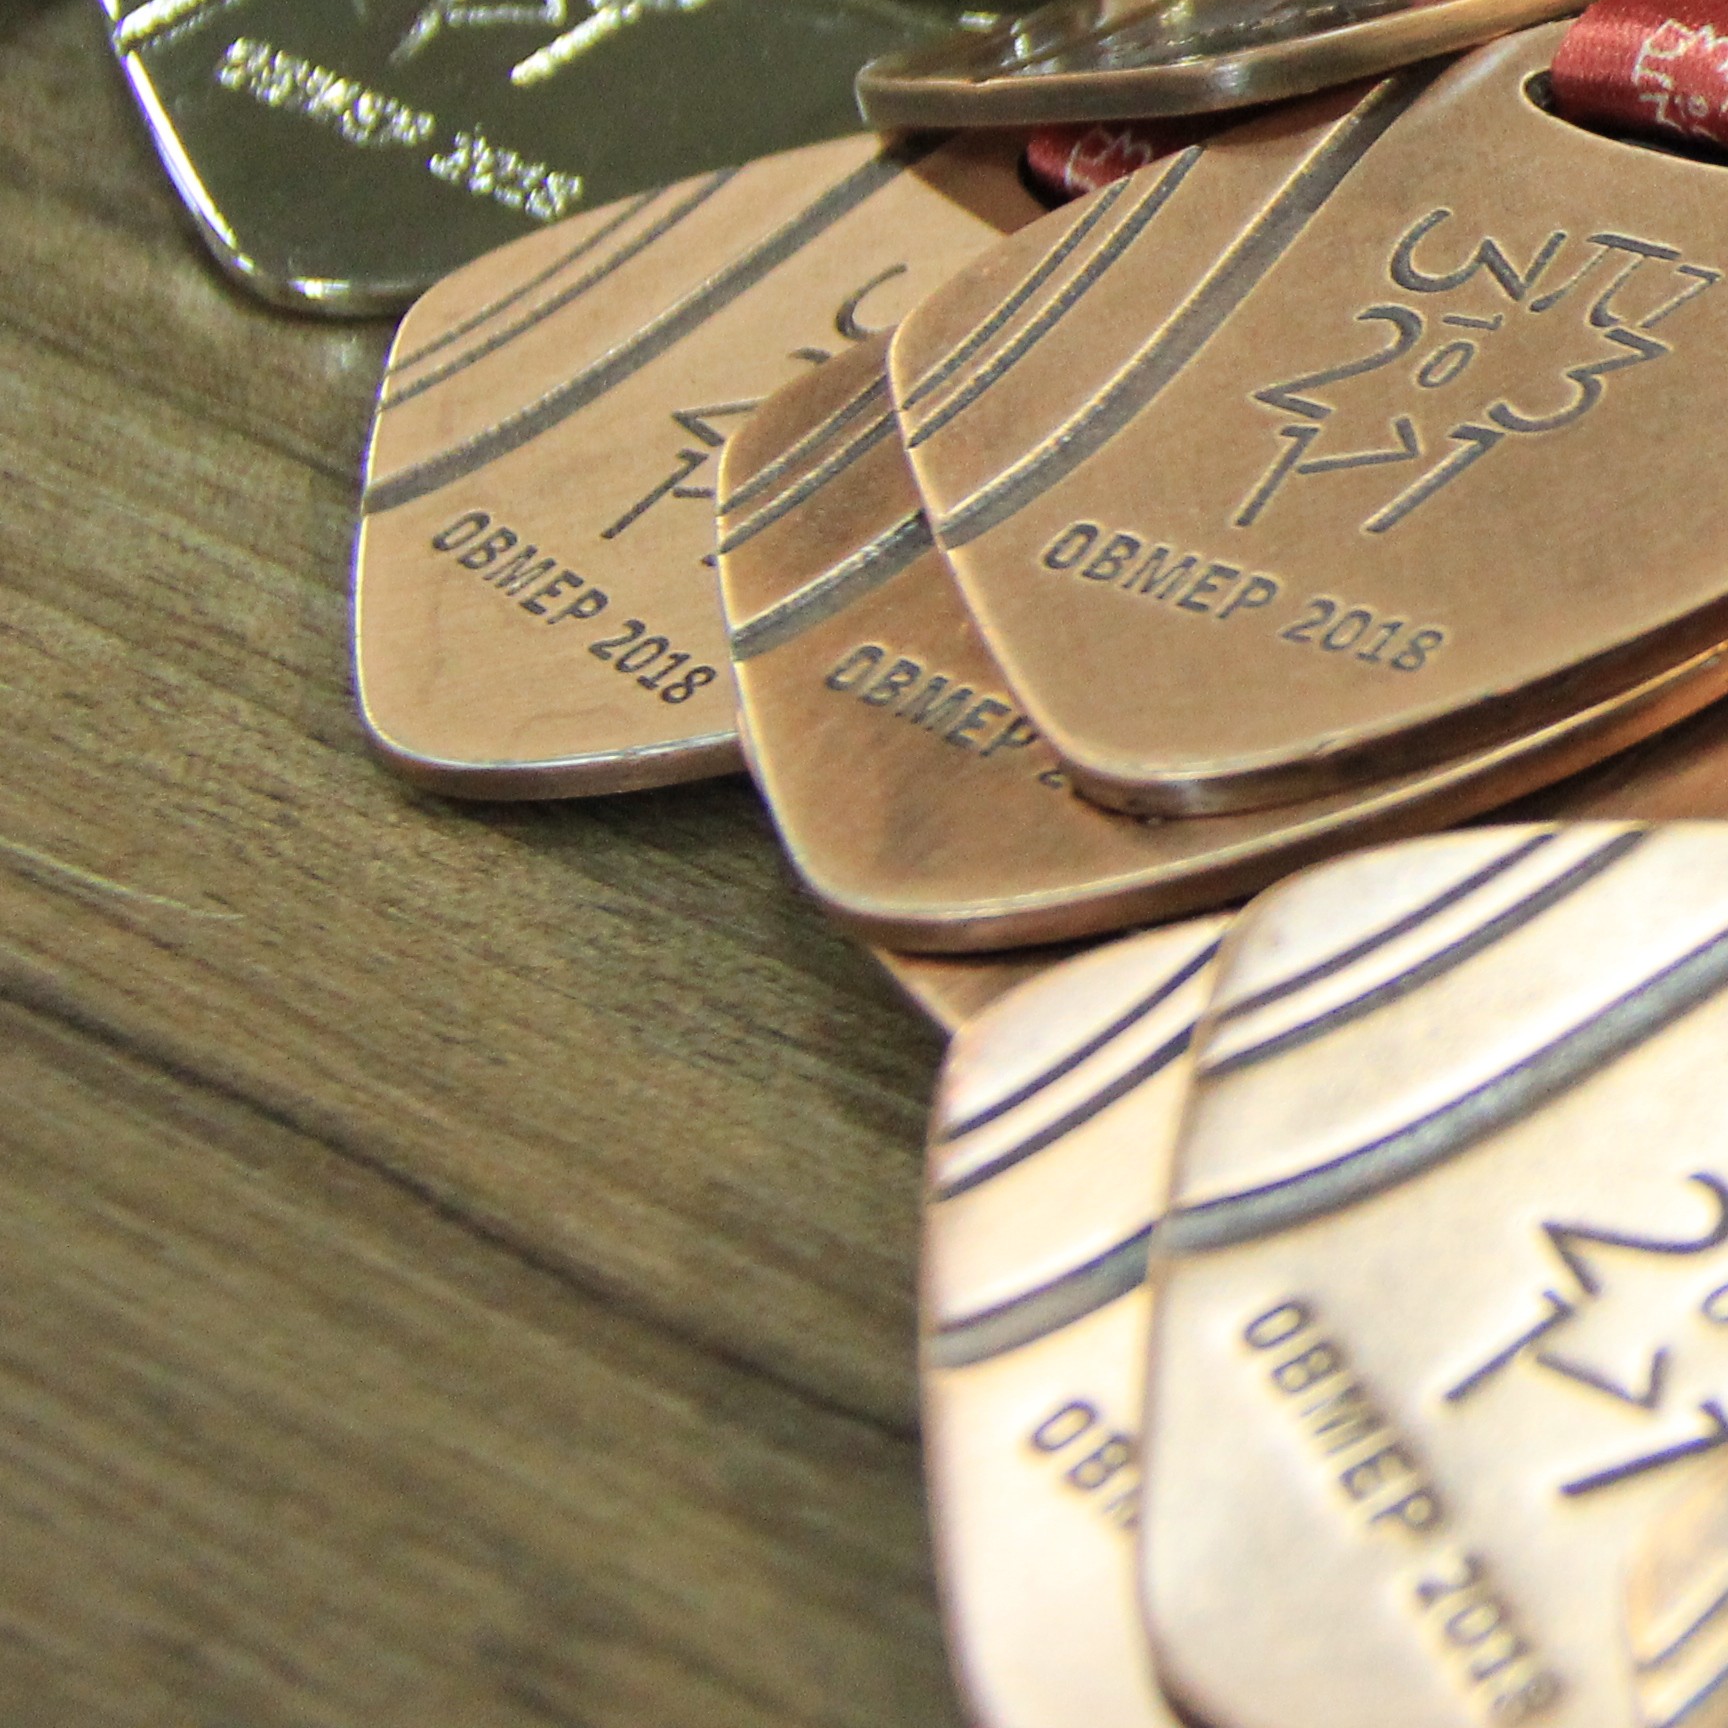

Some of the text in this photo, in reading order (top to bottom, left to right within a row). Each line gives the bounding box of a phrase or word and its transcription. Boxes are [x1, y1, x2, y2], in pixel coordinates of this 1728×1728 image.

[430, 510, 718, 706] OBMEP 2018
[1041, 522, 1447, 672] OBMEP 2018
[824, 643, 1039, 760] OBMEP
[1244, 1299, 1565, 1728] OBMEP 2018
